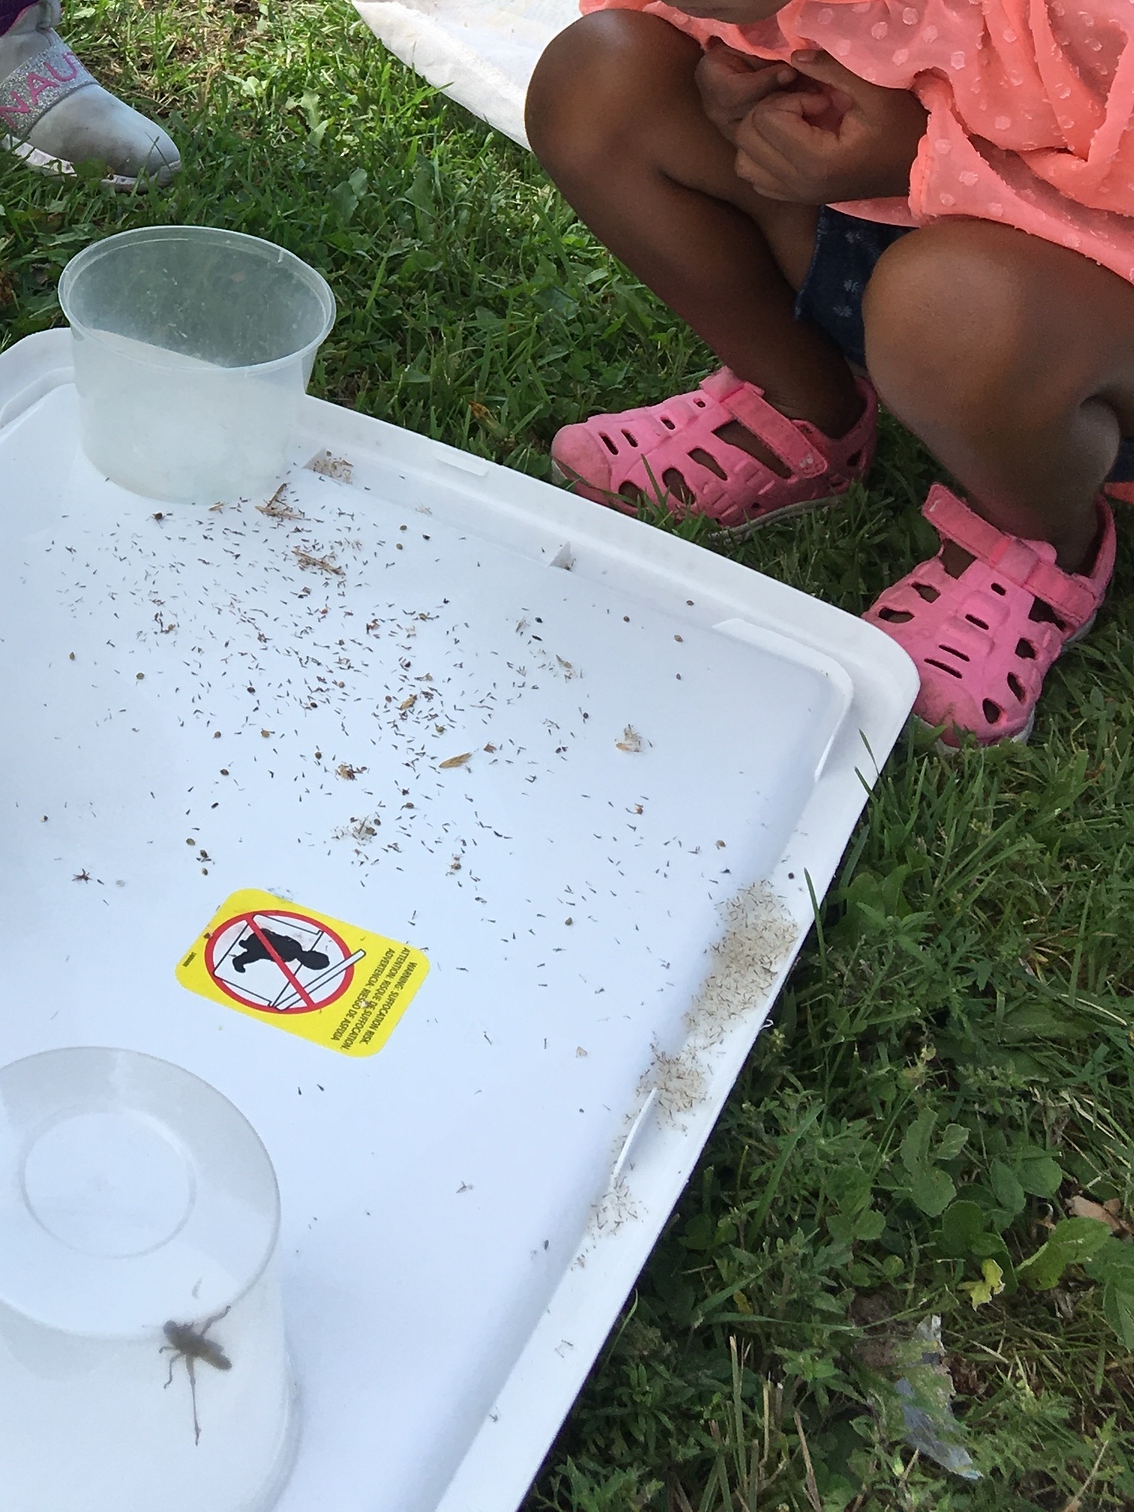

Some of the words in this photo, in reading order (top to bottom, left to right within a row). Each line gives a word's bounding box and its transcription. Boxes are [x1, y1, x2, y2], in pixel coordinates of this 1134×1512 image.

[395, 962, 417, 991] WARNING:
[352, 988, 371, 1010] RIESGO
[372, 980, 391, 1001] RISQUE
[346, 1009, 357, 1019] DE
[366, 1001, 377, 1010] DE
[369, 991, 399, 1031] SUFFOCATION
[331, 1018, 351, 1041] ASFIXIA
[359, 1029, 375, 1044] RISK.
